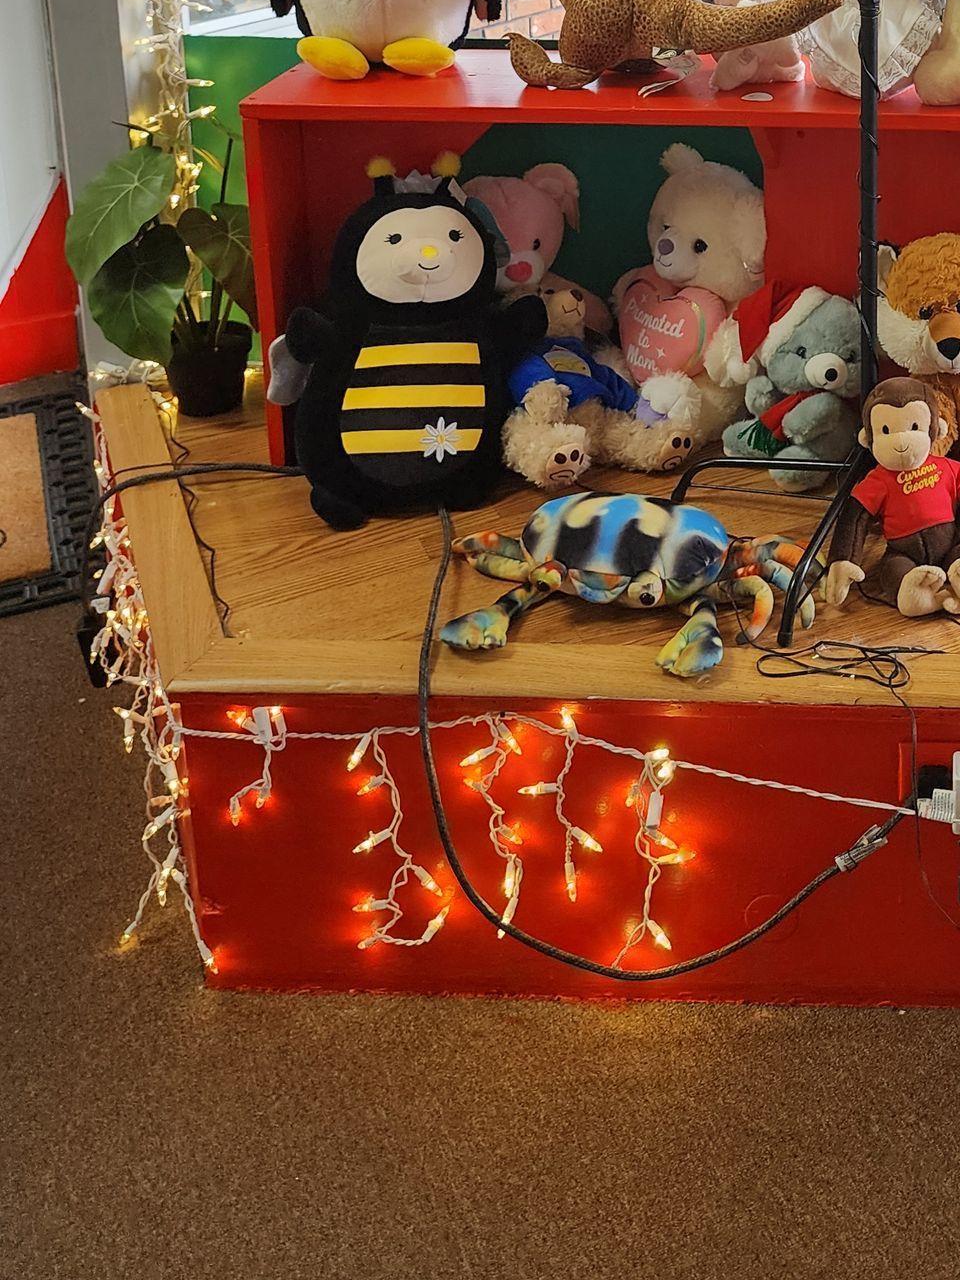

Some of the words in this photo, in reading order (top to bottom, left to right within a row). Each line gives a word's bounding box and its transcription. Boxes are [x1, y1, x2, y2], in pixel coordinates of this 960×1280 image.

[626, 300, 684, 338] Promoted
[638, 329, 651, 348] to
[626, 343, 657, 371] Mom
[896, 463, 938, 484] Curious
[902, 473, 942, 495] George
